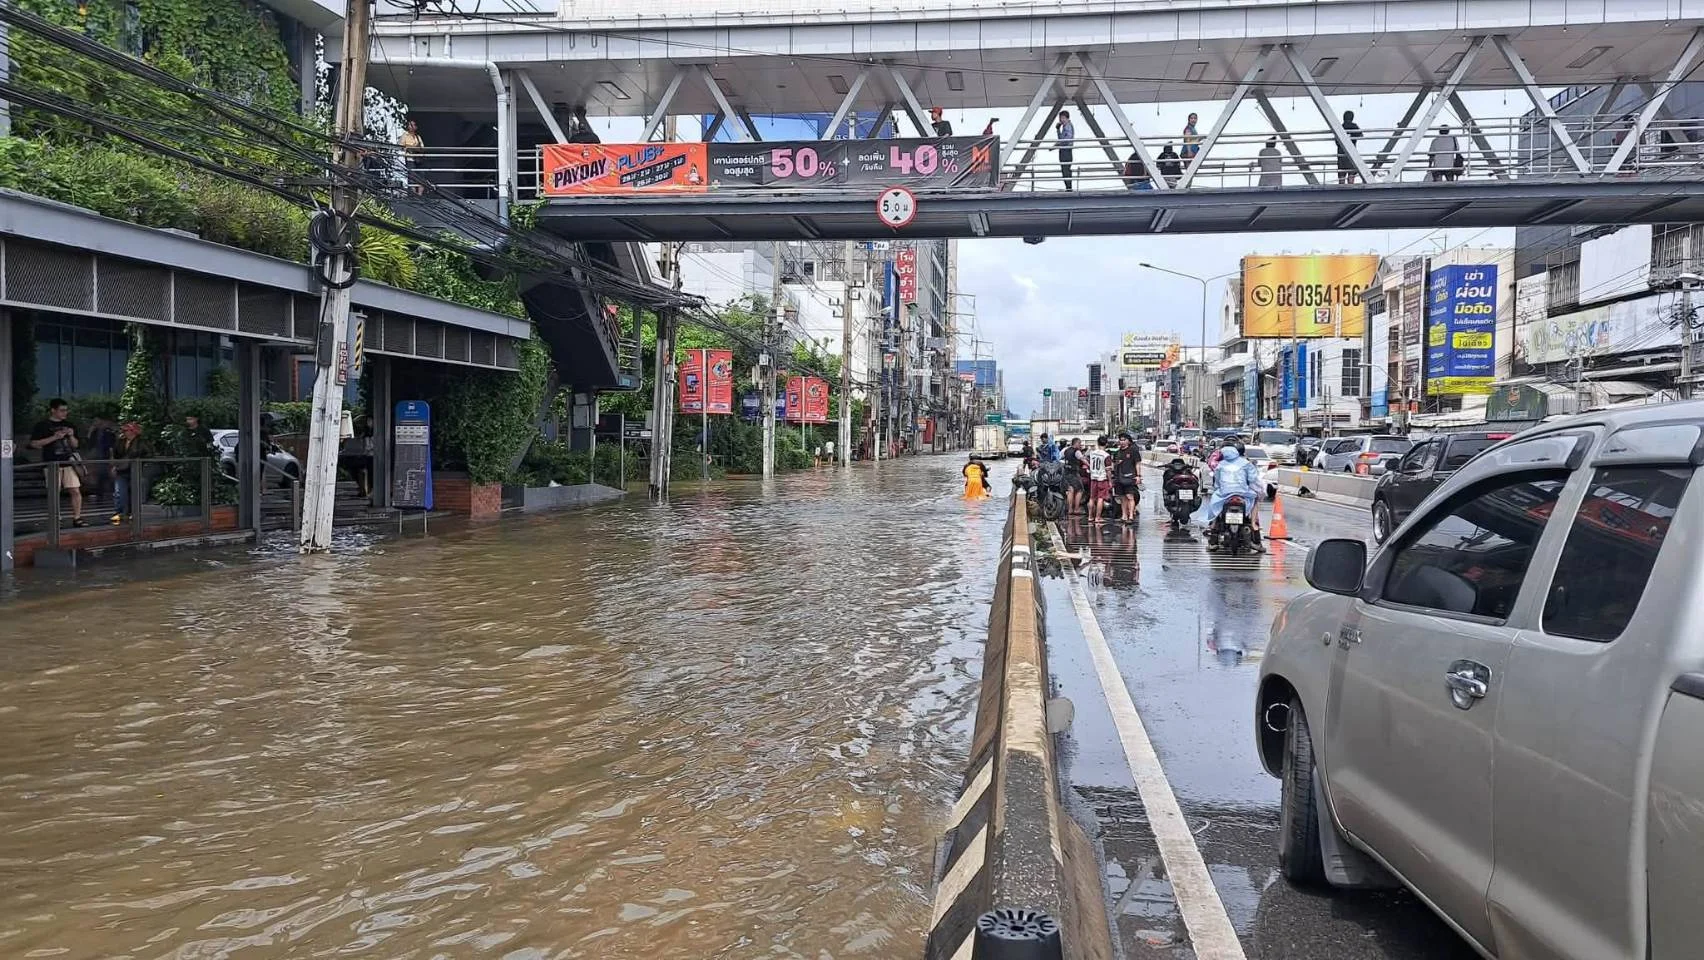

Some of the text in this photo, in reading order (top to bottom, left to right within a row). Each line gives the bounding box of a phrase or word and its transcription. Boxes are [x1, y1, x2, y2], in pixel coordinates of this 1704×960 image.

[713, 154, 765, 165] เคาน์เตอร์ปกติ
[858, 150, 885, 162] ลดเพิ่ม
[554, 158, 607, 188] PAYDAY
[1464, 269, 1484, 280] เช่า
[1455, 283, 1493, 298] ผ่อน
[1454, 302, 1492, 314] มือถือ
[1092, 457, 1101, 470] 10
